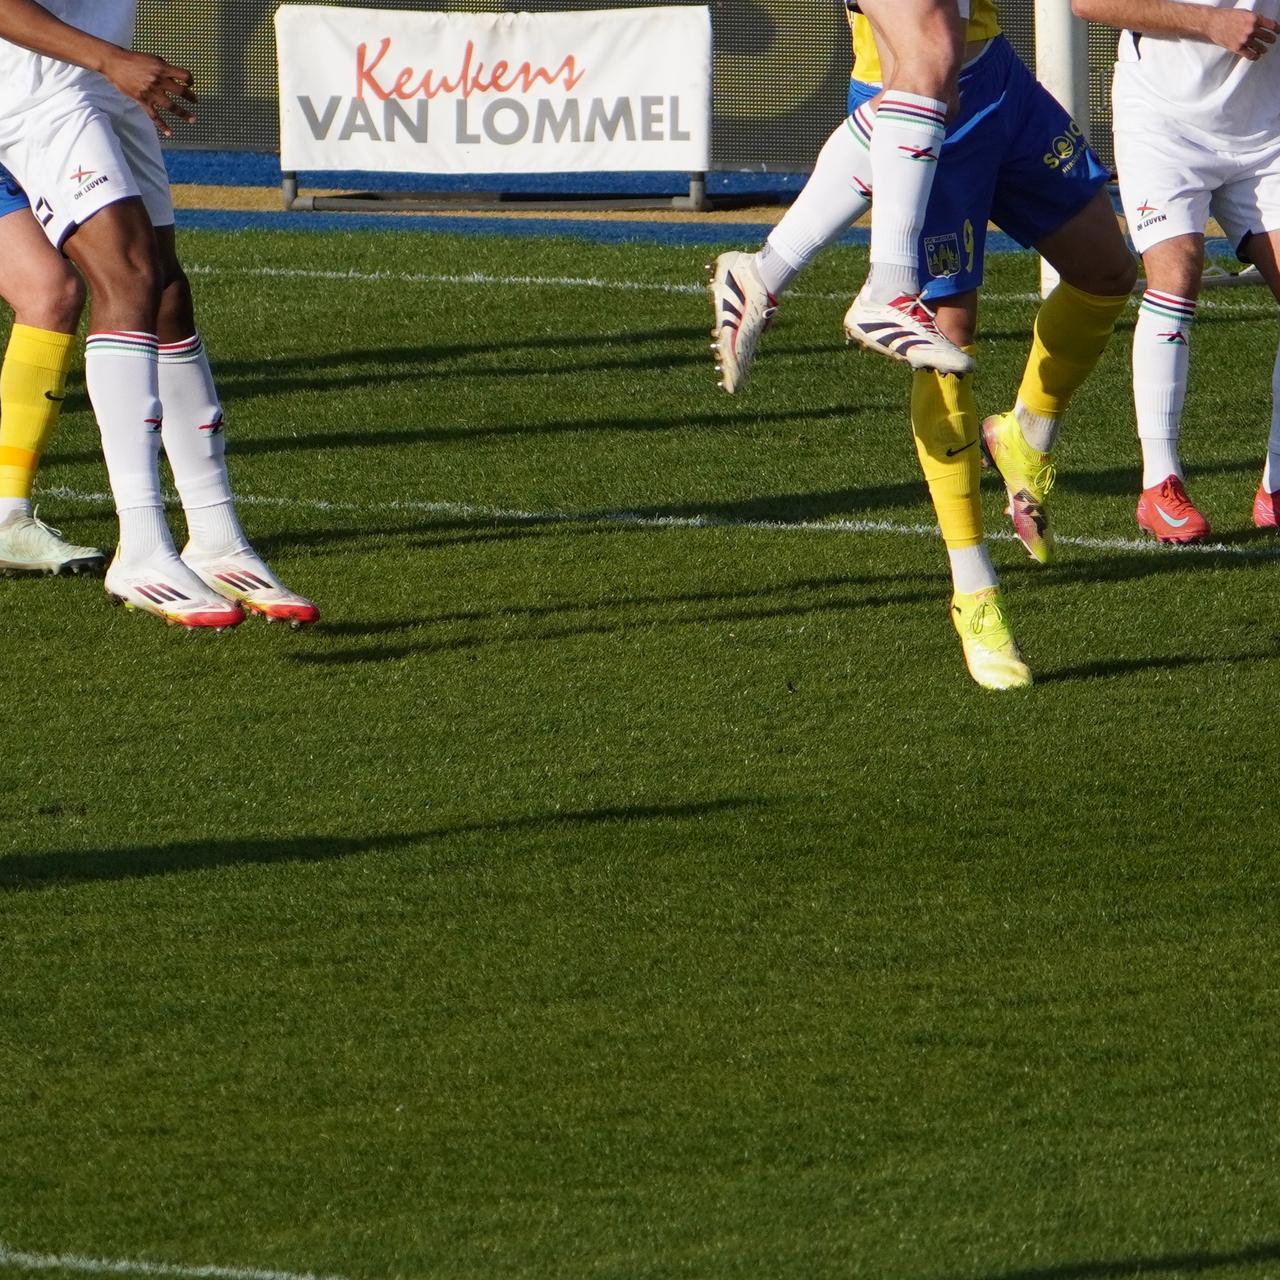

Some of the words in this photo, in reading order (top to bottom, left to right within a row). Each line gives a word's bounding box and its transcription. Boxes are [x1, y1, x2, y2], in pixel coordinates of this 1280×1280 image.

[355, 36, 586, 101] Keukens
[296, 94, 429, 143] VAN
[454, 95, 691, 144] LOMMEL
[73, 191, 84, 201] OH
[84, 174, 109, 193] LEUVEN
[1143, 214, 1168, 229] LEUVEN
